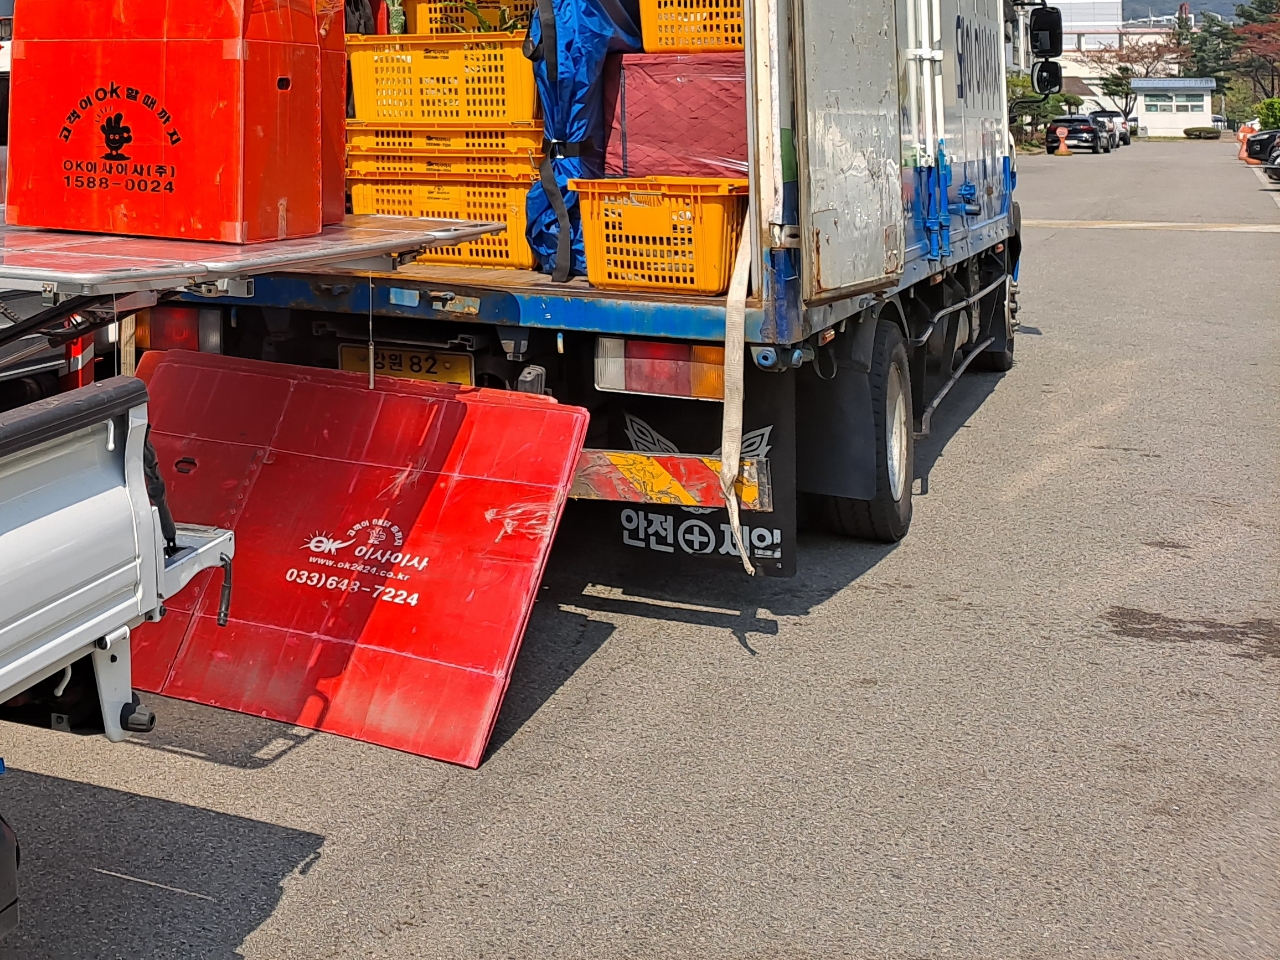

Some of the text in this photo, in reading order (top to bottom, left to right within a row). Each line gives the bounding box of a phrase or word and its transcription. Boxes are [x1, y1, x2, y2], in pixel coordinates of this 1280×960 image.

[63, 175, 175, 193] 1588-0024
[409, 355, 438, 374] 82
[620, 508, 675, 553] 안전
[308, 555, 410, 582] www.ok2424.co.kr
[354, 545, 430, 571] 이사이사
[285, 568, 420, 607] 033)648-7224
